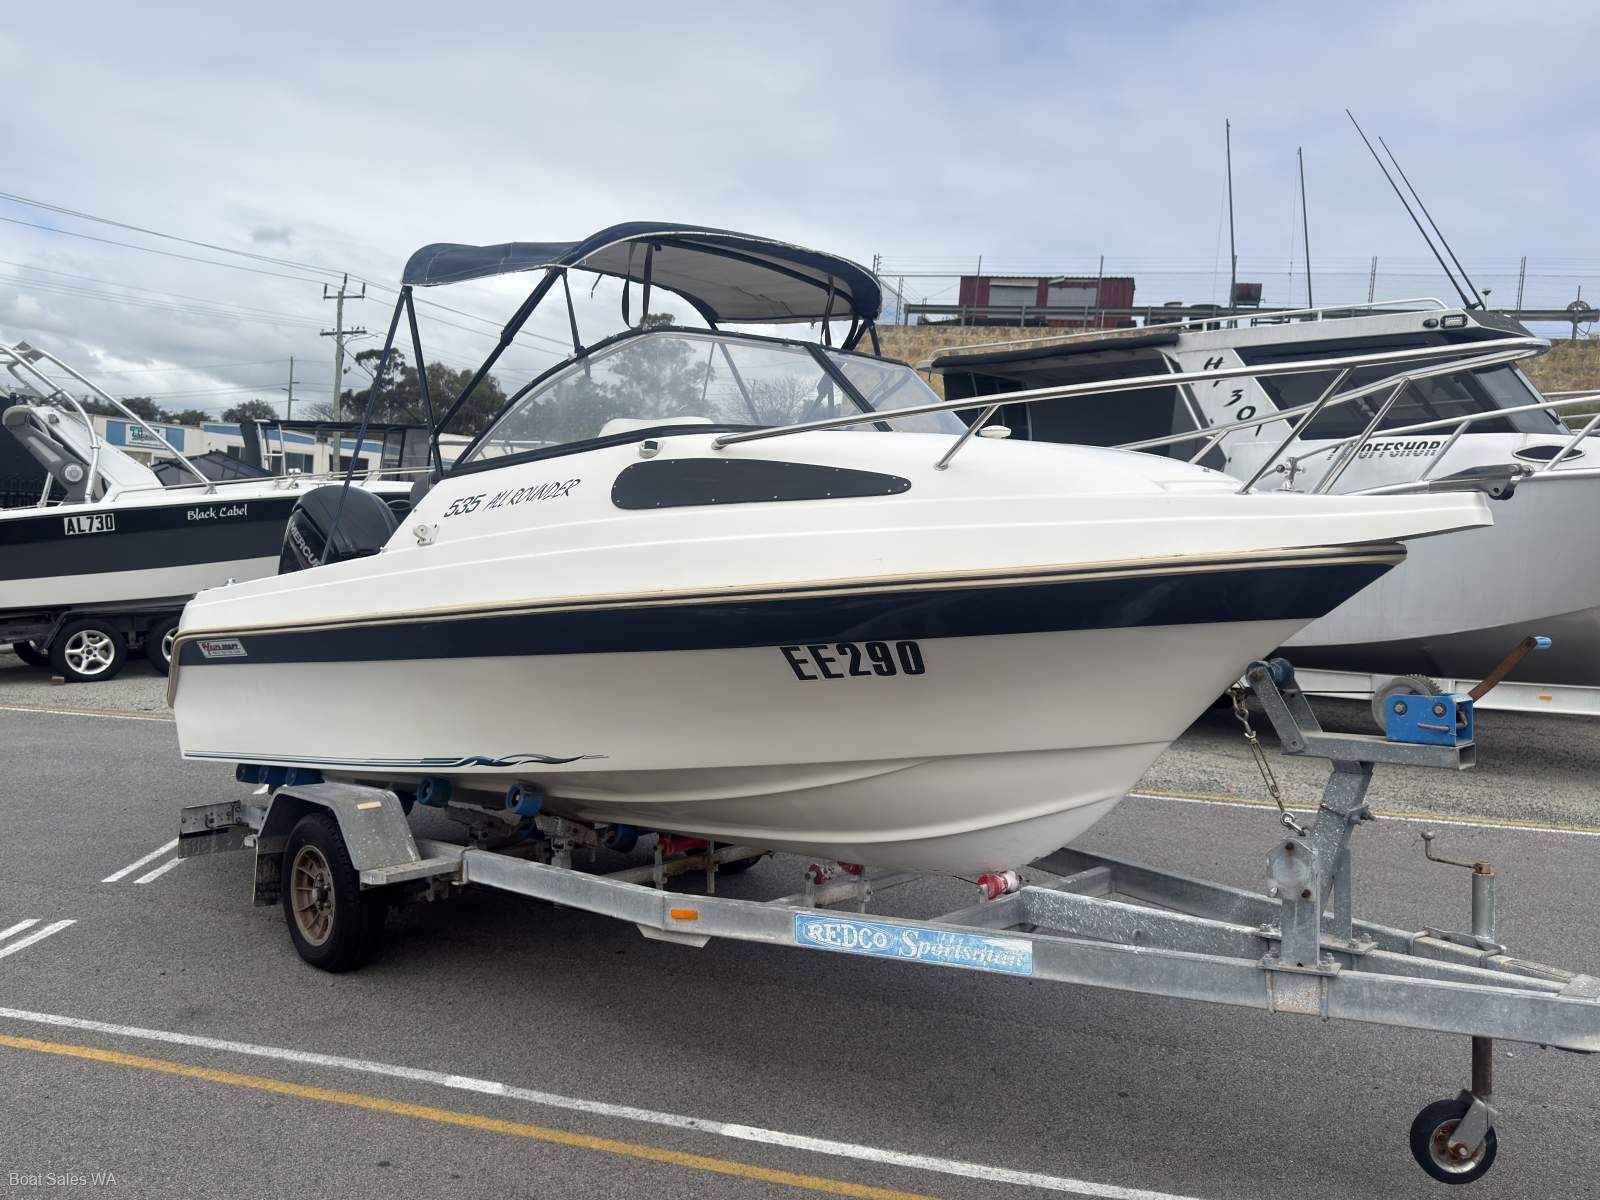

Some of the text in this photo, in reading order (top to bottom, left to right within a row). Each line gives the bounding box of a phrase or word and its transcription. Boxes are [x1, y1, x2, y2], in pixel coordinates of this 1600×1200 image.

[1359, 441, 1448, 459] OFFSHOR
[444, 478, 581, 518] 535 ALL ROUNDER
[187, 504, 248, 521] Black Label
[66, 514, 114, 534] AL730
[779, 641, 926, 681] EE290
